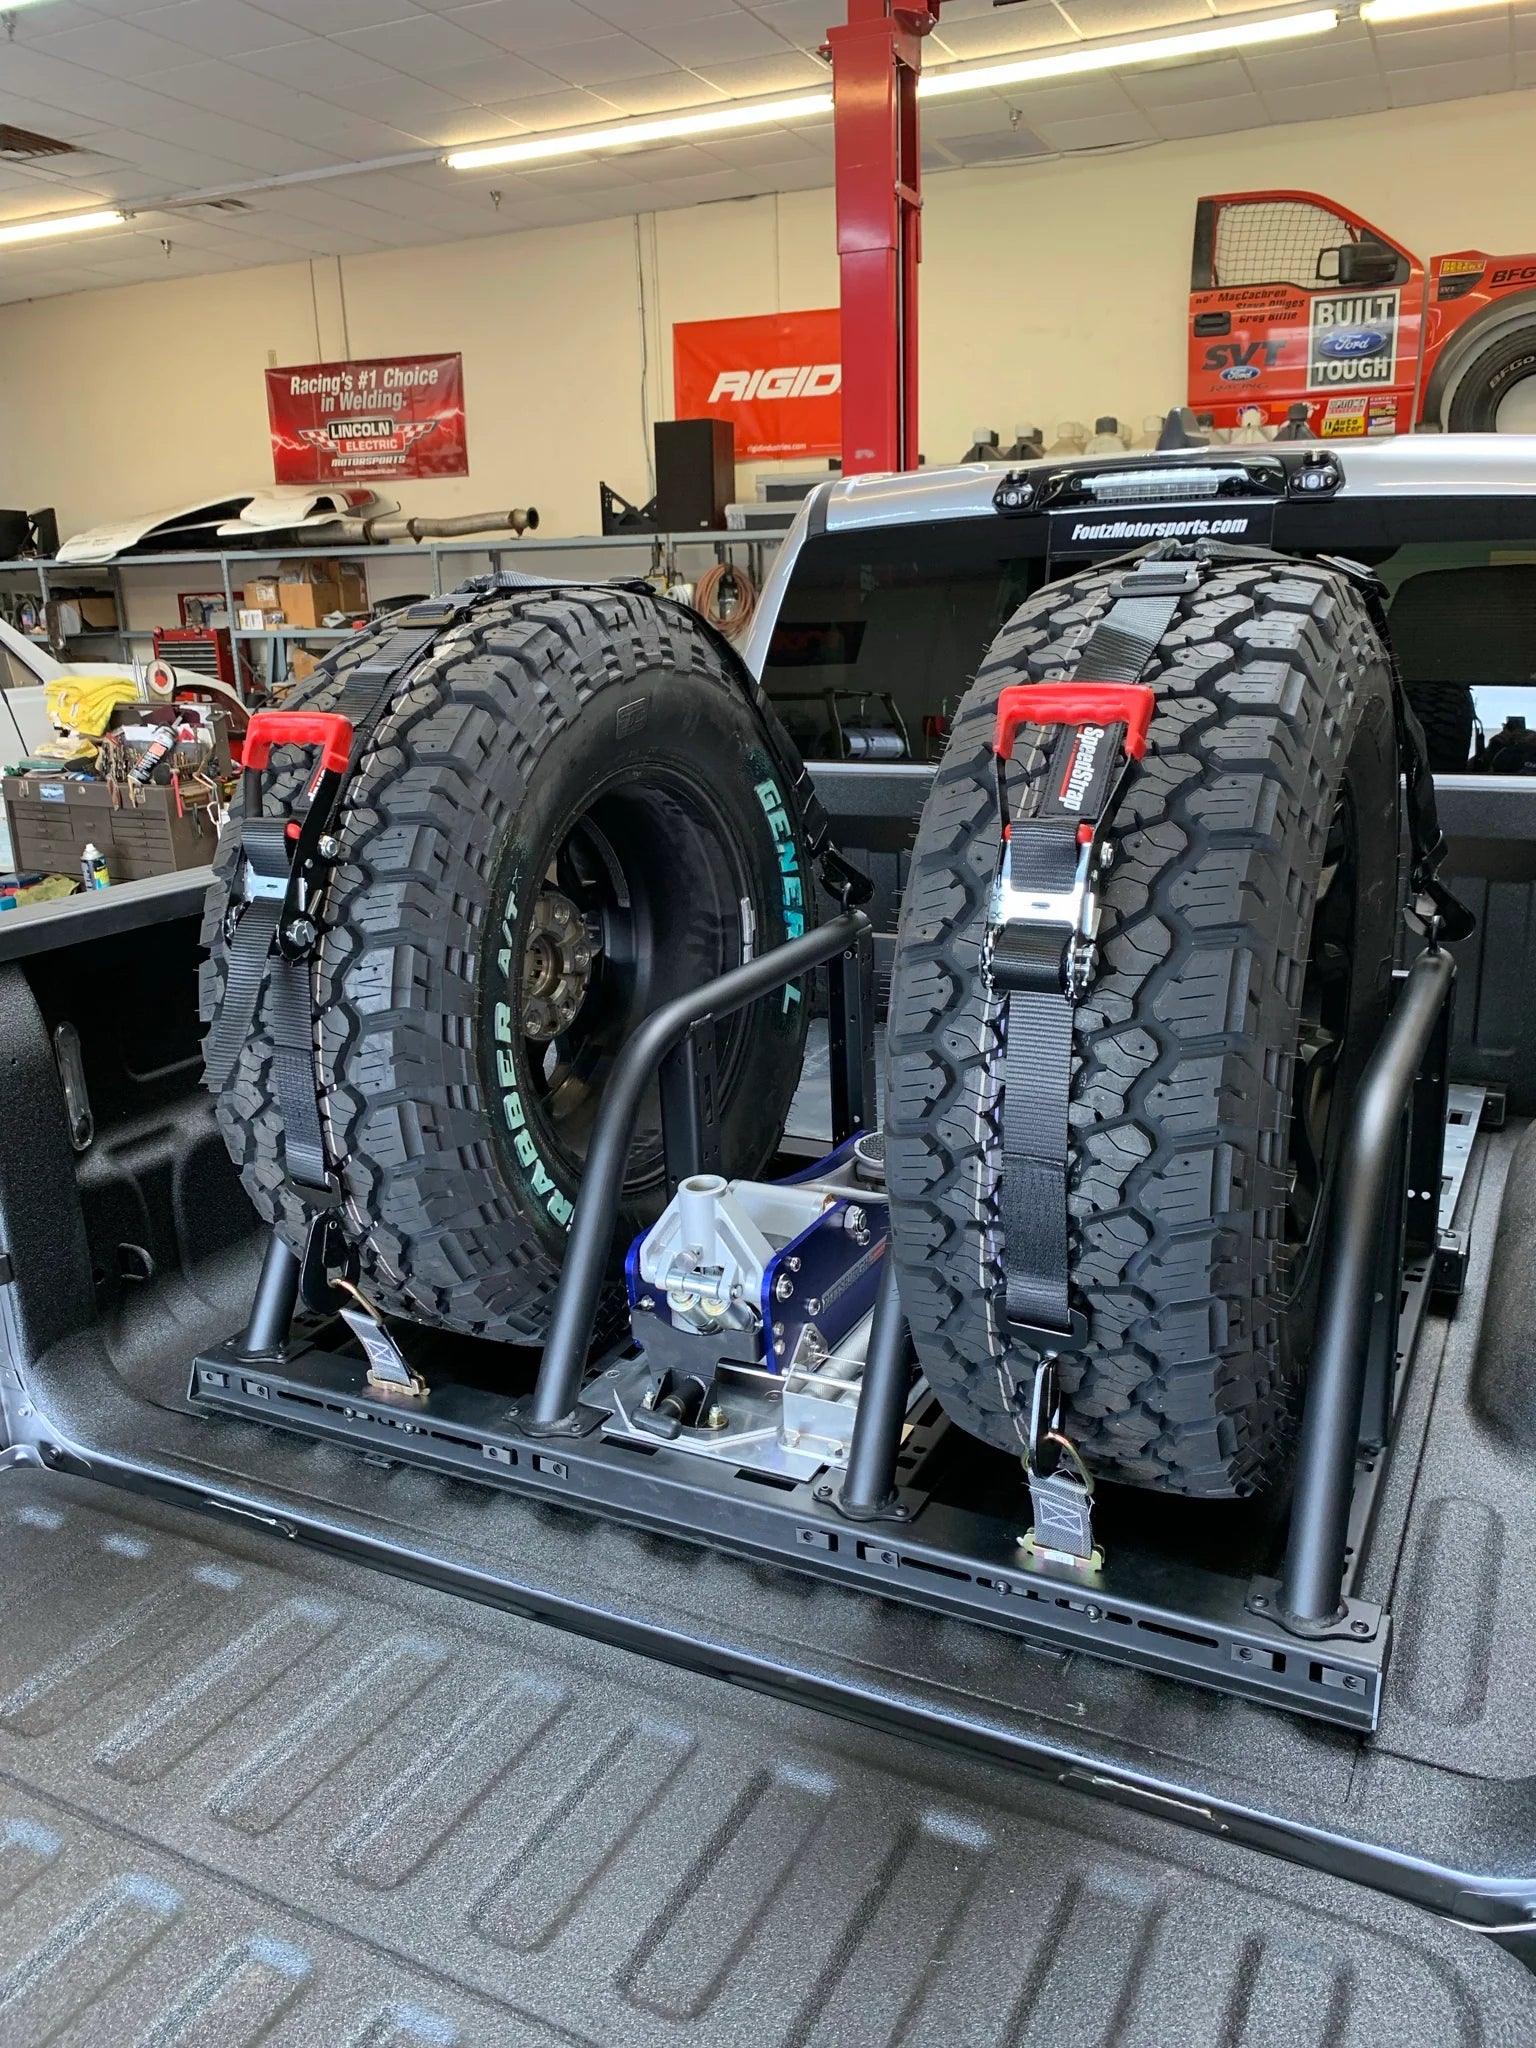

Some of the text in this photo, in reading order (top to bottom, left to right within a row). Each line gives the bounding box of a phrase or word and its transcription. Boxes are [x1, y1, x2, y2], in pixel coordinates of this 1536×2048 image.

[1317, 297, 1394, 328] BUILT
[1335, 334, 1370, 351] Ford
[1202, 340, 1287, 371] SVT
[1227, 367, 1253, 380] Ford
[1314, 356, 1389, 382] TOUGH
[290, 366, 439, 396] Racing's #1 Choice
[707, 364, 842, 403] RIGID
[320, 393, 335, 413] in
[331, 421, 390, 439] LINCOLN
[1332, 425, 1362, 434] Meter
[1334, 418, 1358, 427] Auto
[345, 438, 398, 452] ELECTRIC
[747, 443, 806, 454] rigidindustries.com
[331, 455, 406, 467] MOTORSPORTS
[1071, 518, 1249, 542] FoutzMotorsports.com
[1058, 726, 1105, 812] SpeedStrap
[754, 778, 805, 1015] GENERL
[494, 1001, 576, 1232] RABBER
